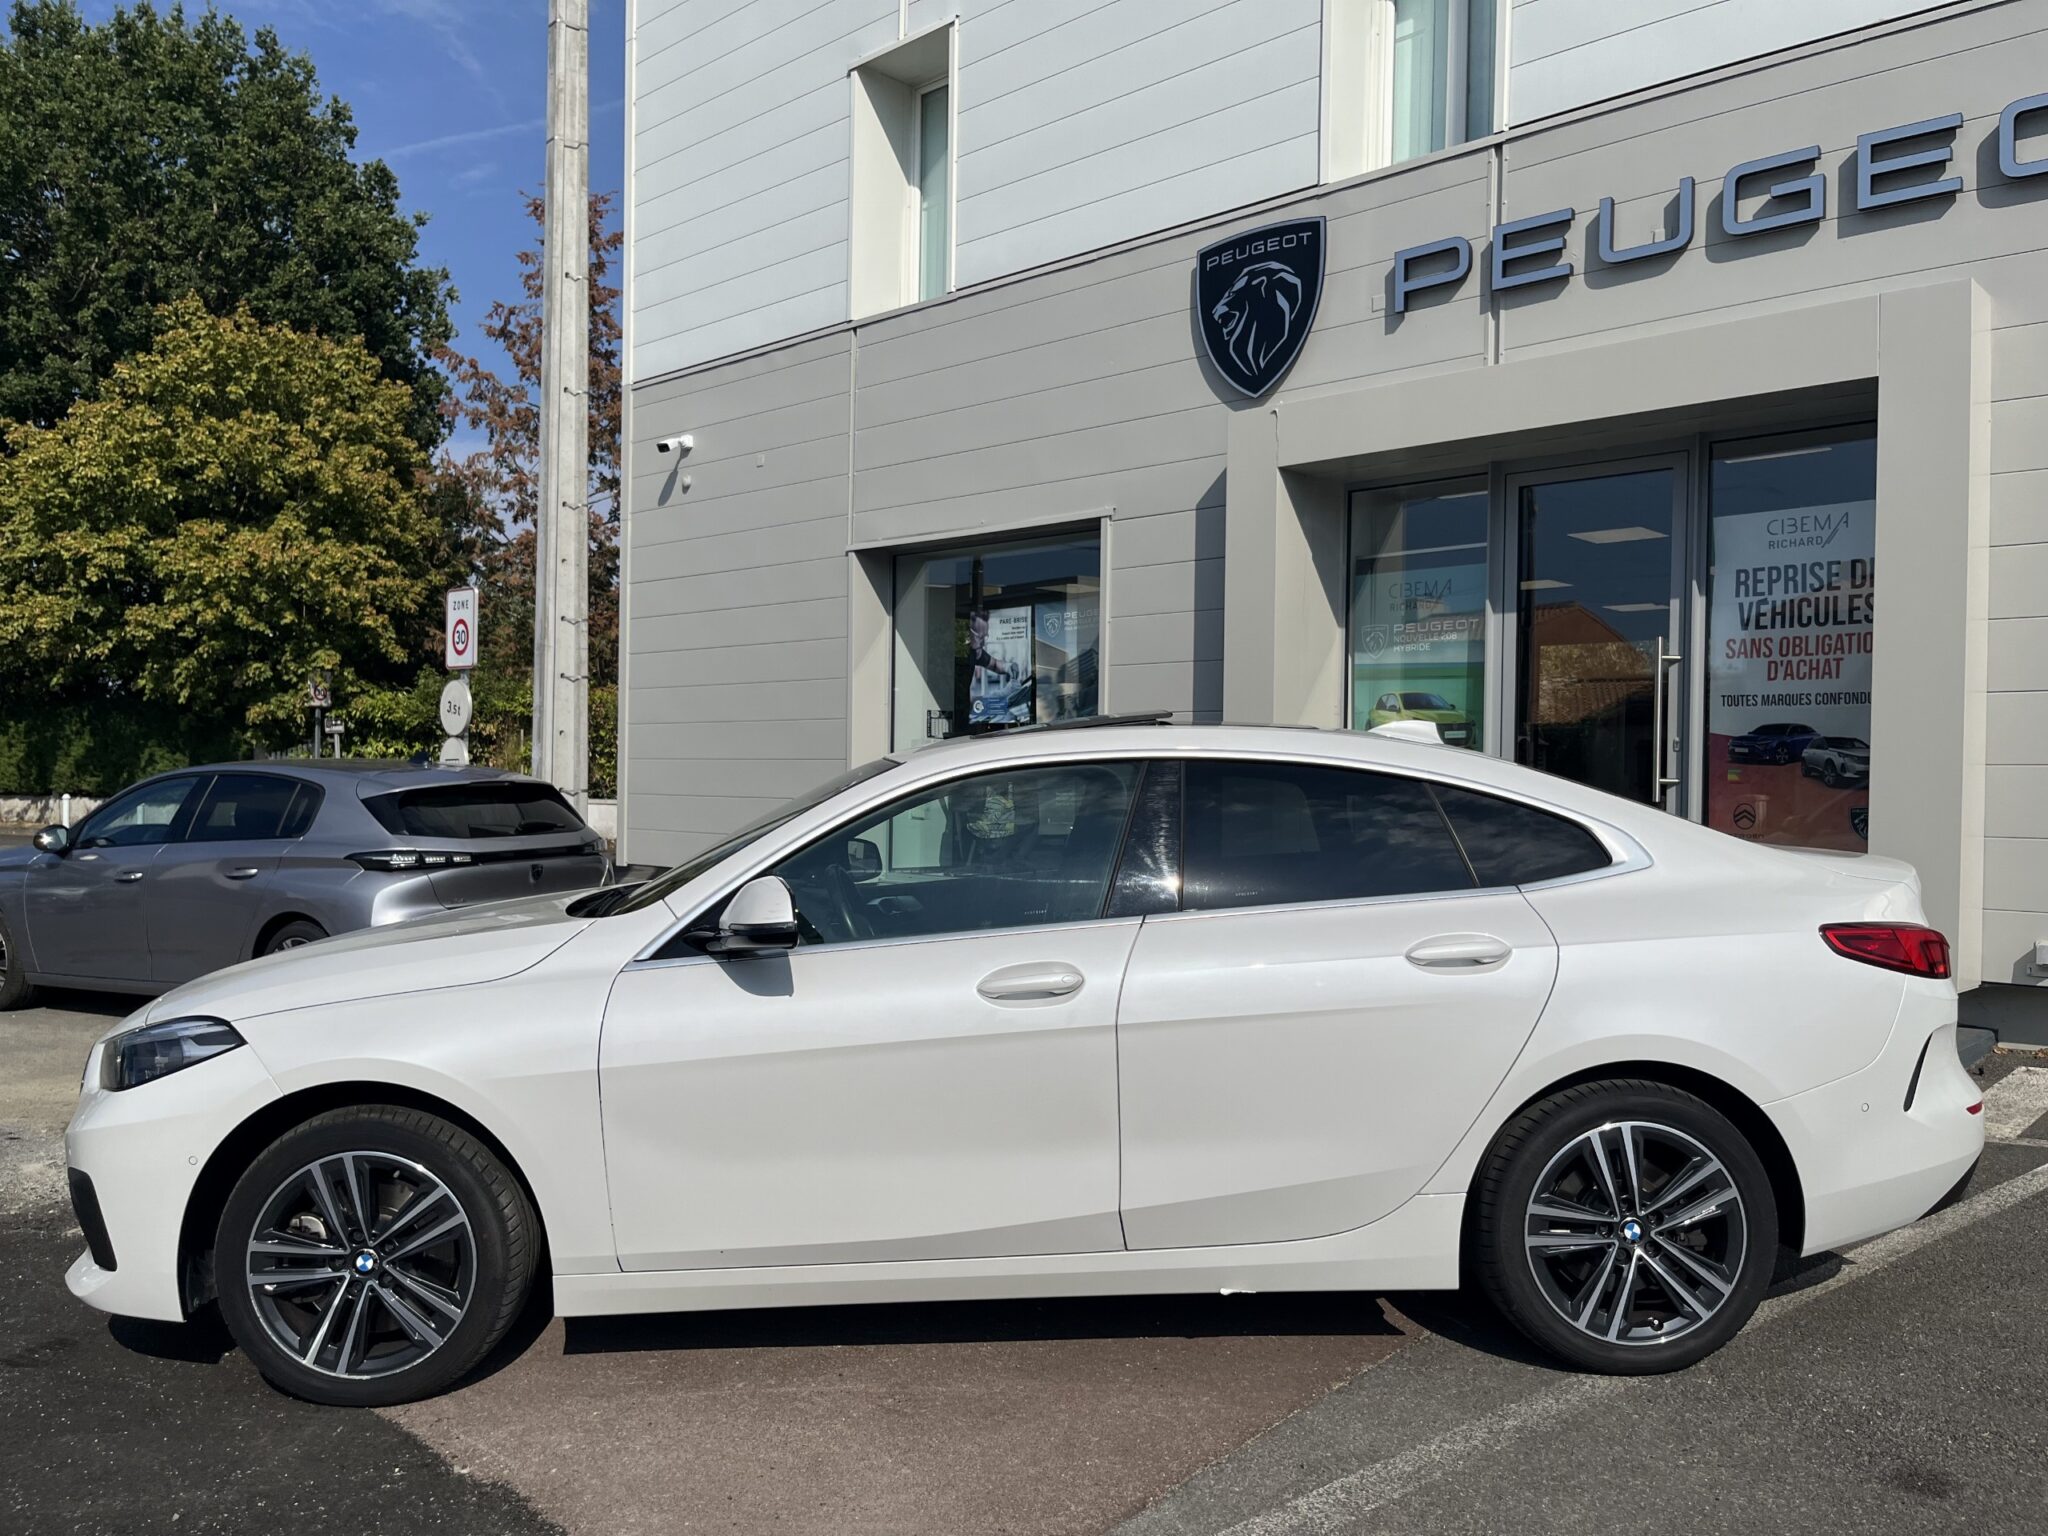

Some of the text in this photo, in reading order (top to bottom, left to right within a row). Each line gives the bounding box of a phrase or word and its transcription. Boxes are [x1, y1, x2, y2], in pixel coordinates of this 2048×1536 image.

[1206, 231, 1313, 272] PEUGEOT
[1768, 535, 1824, 550] RICHARD
[1734, 559, 1842, 598] REPRISE
[453, 600, 469, 611] ZONE
[1738, 592, 1875, 631] VÉHICULES
[1393, 618, 1479, 633] PEUGEOT
[456, 629, 466, 645] 30
[1393, 631, 1458, 643] NOUVELLE 208
[1393, 642, 1431, 653] HYBRIDE
[1725, 636, 1774, 660] SANS
[1767, 657, 1845, 682] D'ACHAT
[1720, 693, 1759, 708] TOUTES
[1760, 692, 1812, 707] MARQUES
